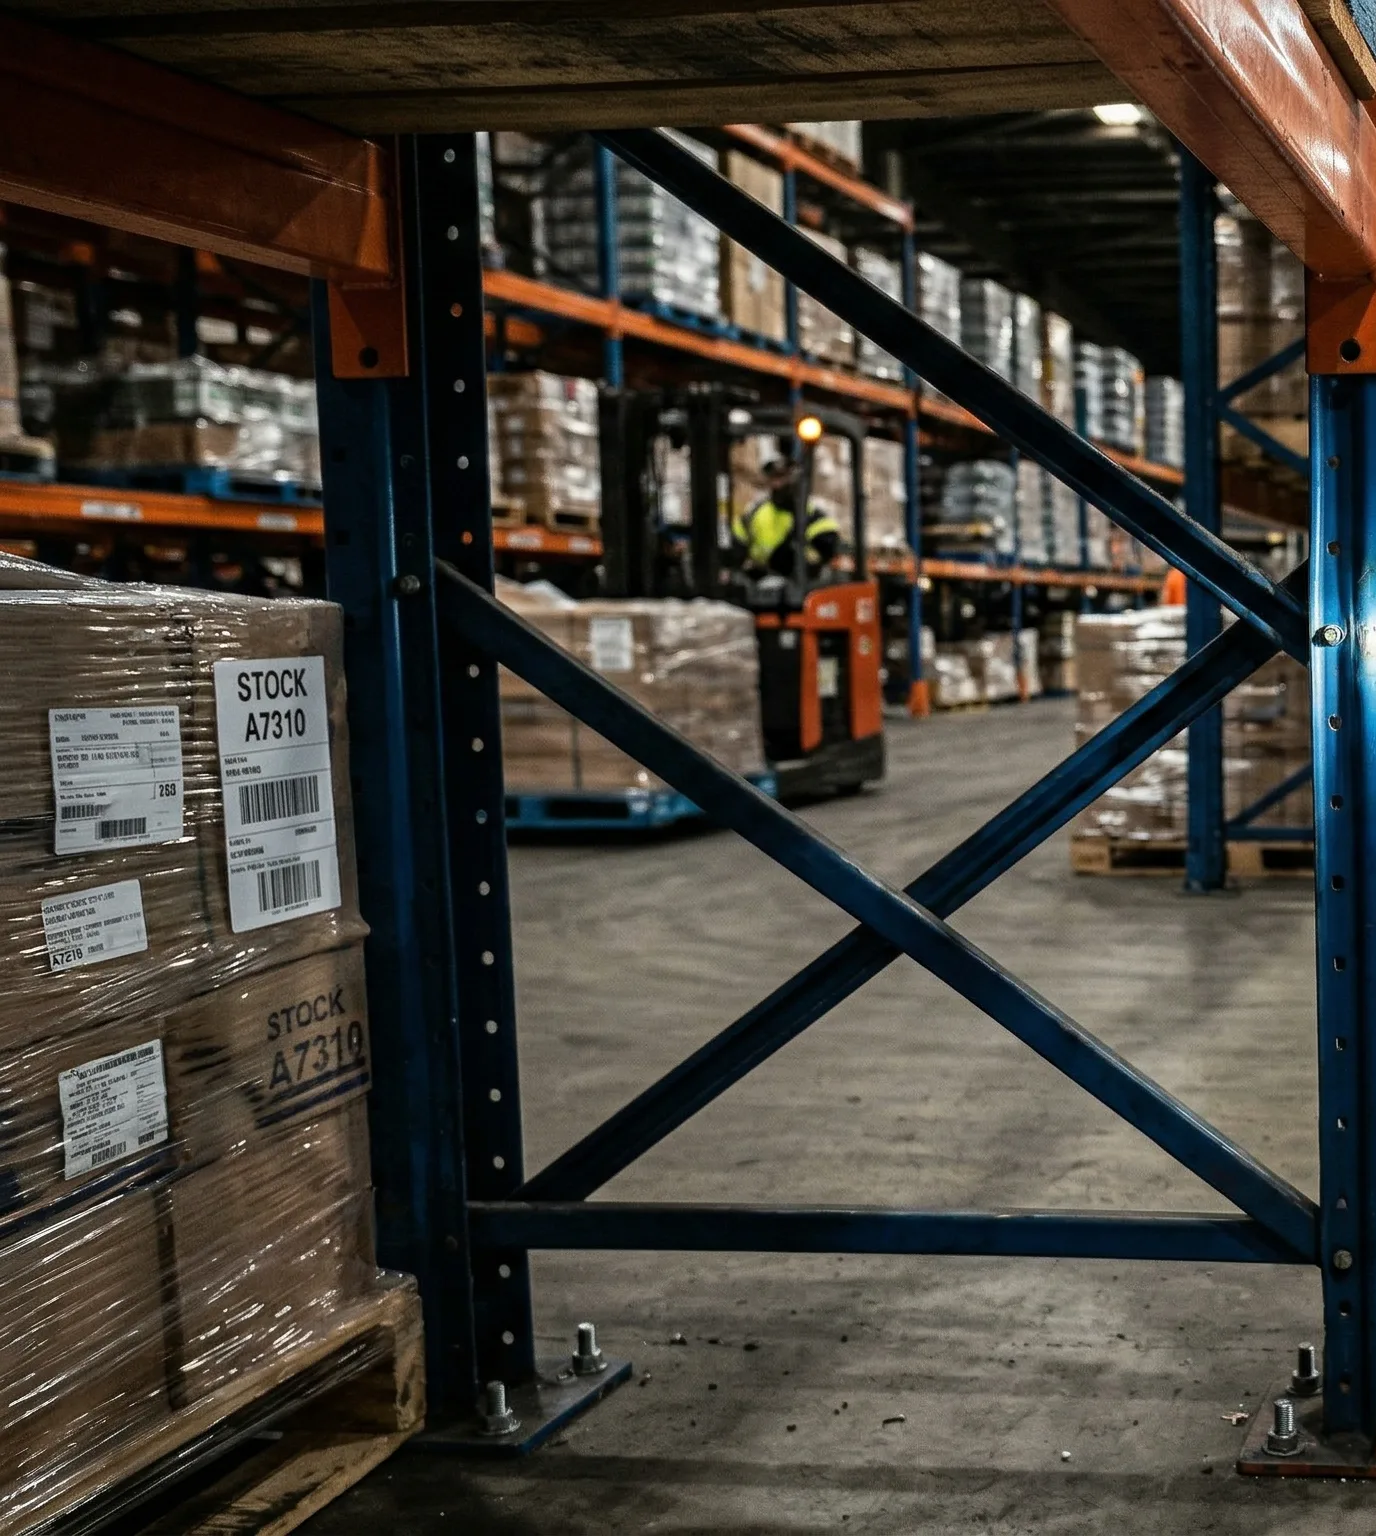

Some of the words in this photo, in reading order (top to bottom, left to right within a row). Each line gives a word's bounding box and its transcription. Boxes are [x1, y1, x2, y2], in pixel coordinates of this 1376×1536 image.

[237, 668, 308, 702] STOCK
[245, 708, 306, 742] A7310
[267, 988, 346, 1041] STOCK
[269, 1021, 363, 1090] A7310
